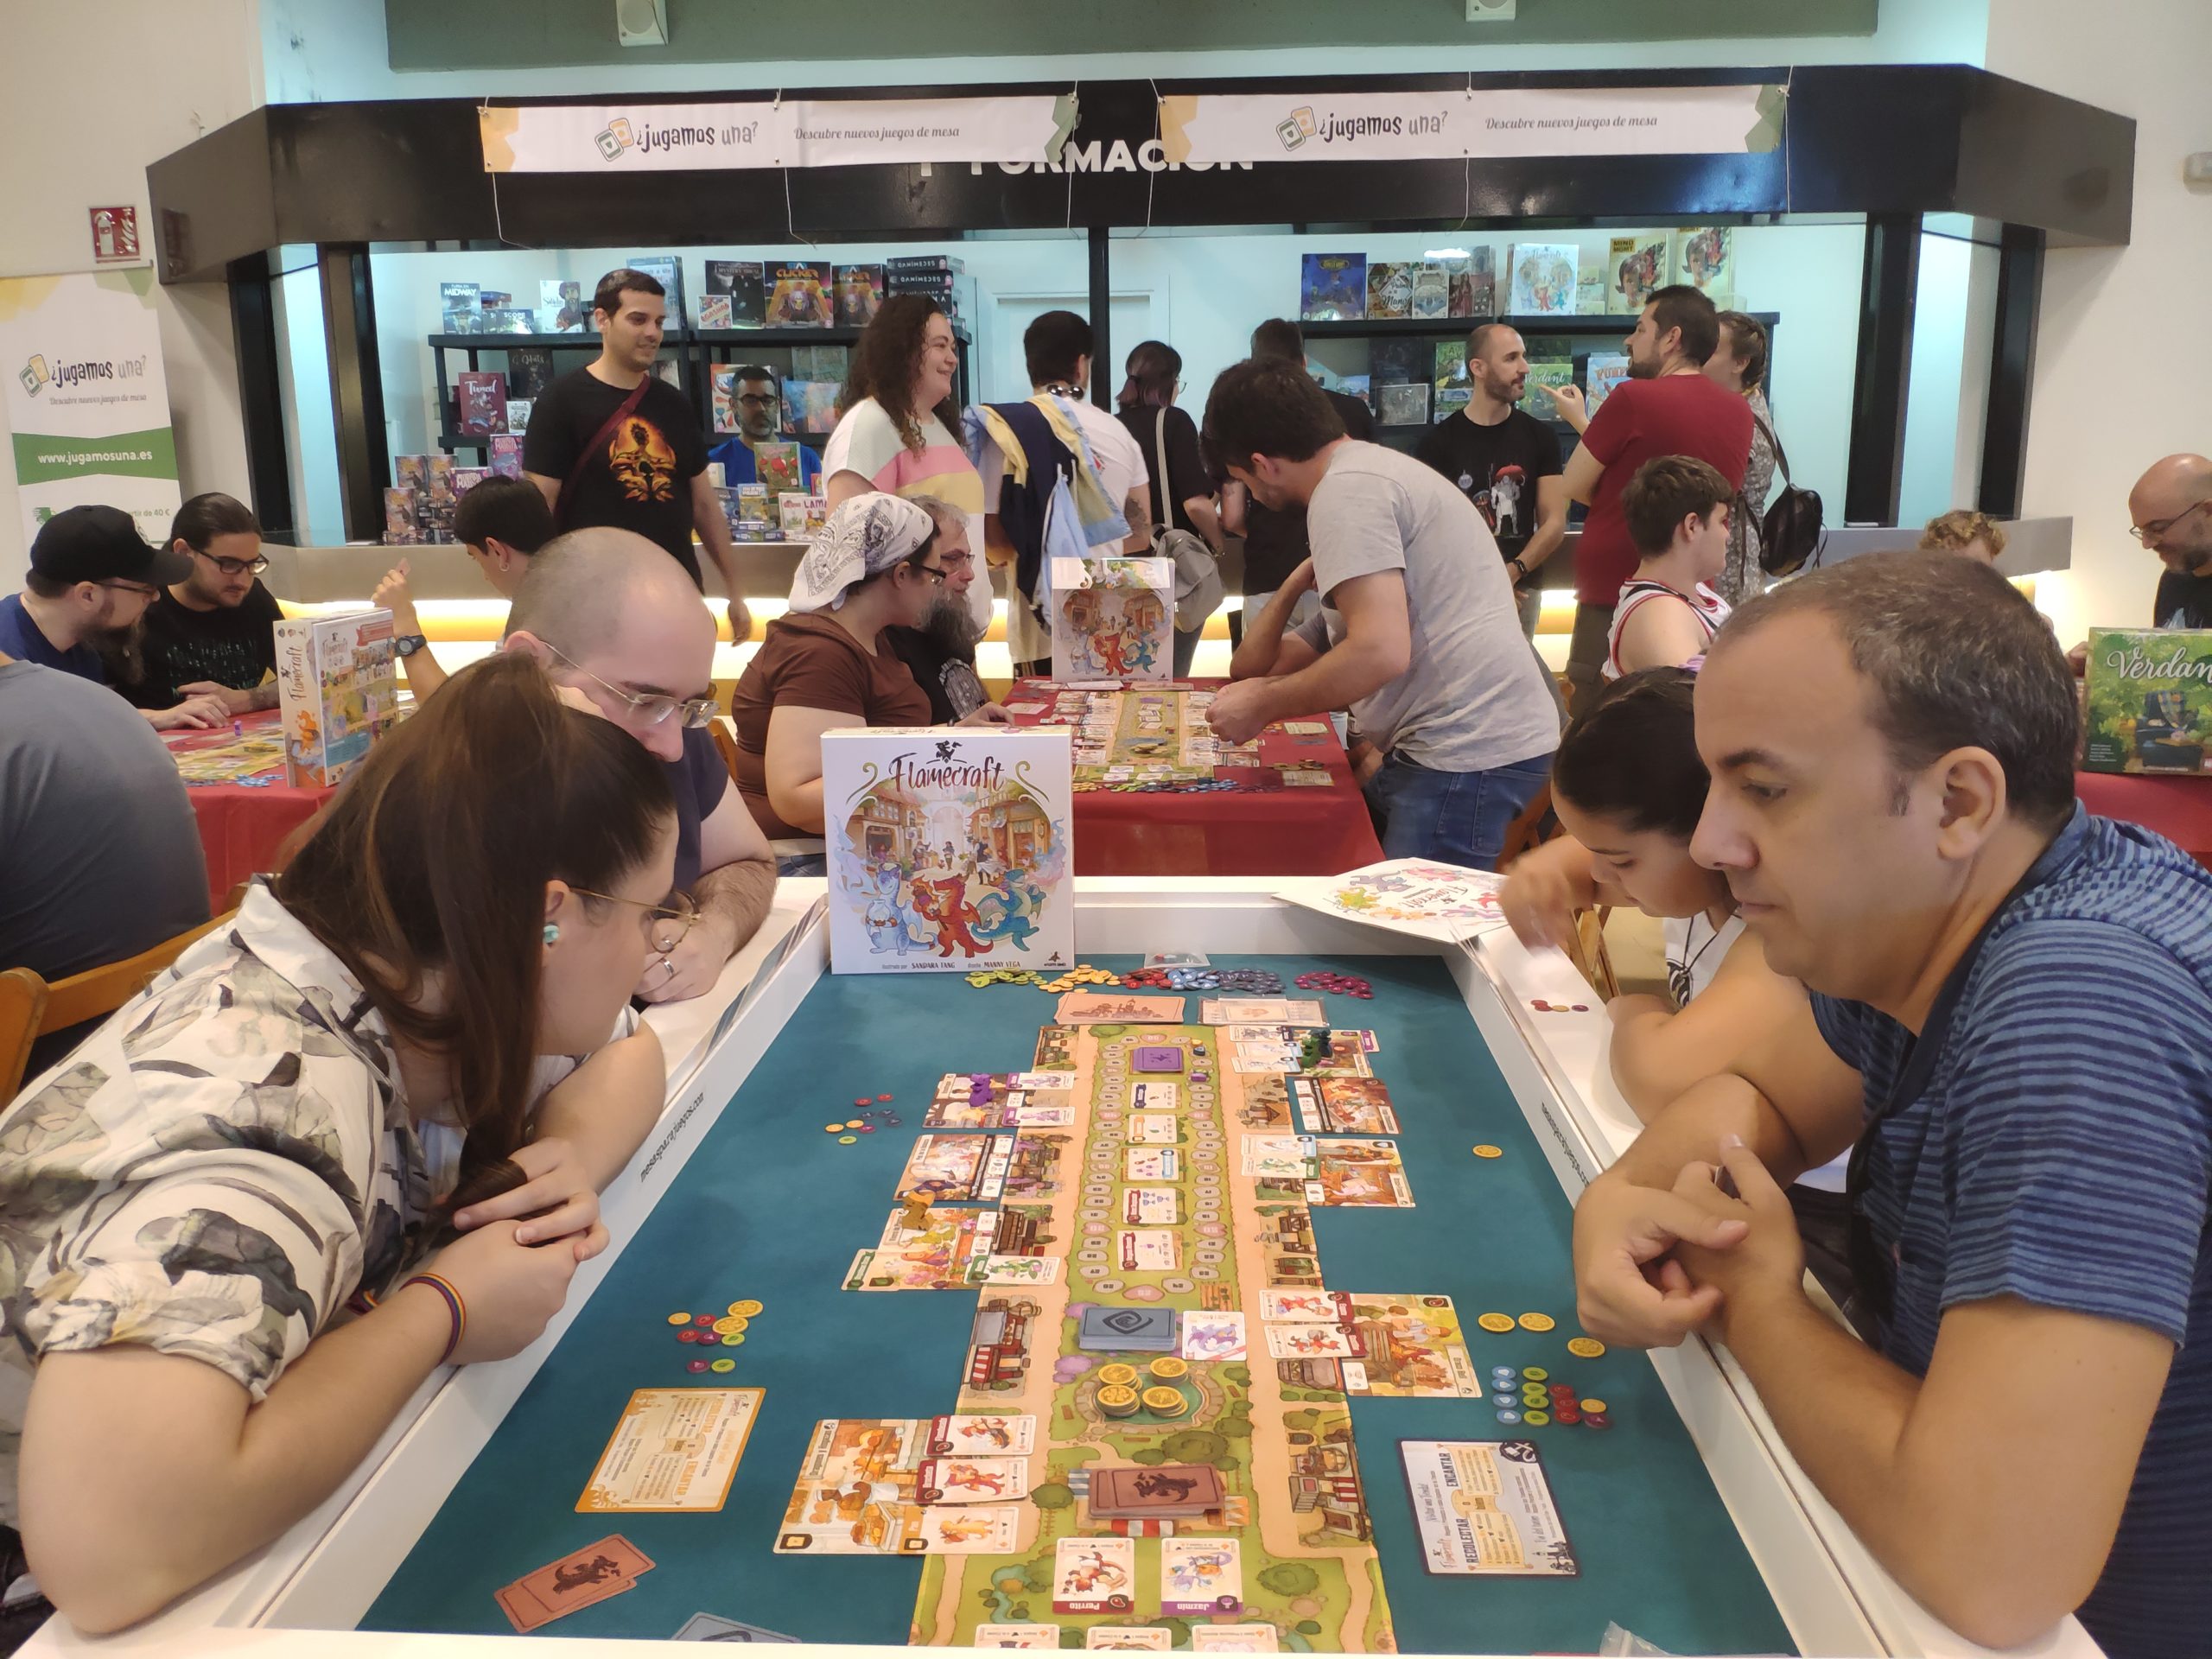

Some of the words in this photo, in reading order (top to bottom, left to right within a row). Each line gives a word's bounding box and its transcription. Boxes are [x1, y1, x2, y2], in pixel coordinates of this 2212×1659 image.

[637, 124, 715, 153] ¿jugamos
[721, 122, 759, 145] una?
[794, 127, 842, 140] Descubre
[844, 129, 879, 139] nuevos
[879, 128, 914, 141] juegos
[916, 126, 930, 137] de
[931, 127, 960, 137] mesa
[1319, 112, 1402, 143] ¿jugamos
[1408, 111, 1448, 136] una?
[1485, 118, 1535, 130] Descubre
[1537, 118, 1573, 129] nuevos
[1573, 118, 1611, 130] juegos
[1613, 117, 1625, 127] de
[1628, 118, 1657, 127] mesa
[444, 288, 477, 296] MIDWAY
[51, 359, 114, 388] ¿jugamos
[118, 355, 147, 379] una?
[38, 450, 153, 465] www.jugamosuna.es
[2107, 646, 2212, 683] Verdan
[888, 752, 1005, 791] Flamecraft
[1439, 1452, 1459, 1487] ENCANTAR
[1456, 1518, 1478, 1563] RECOLECTAR
[1069, 1602, 1100, 1611] Perrito
